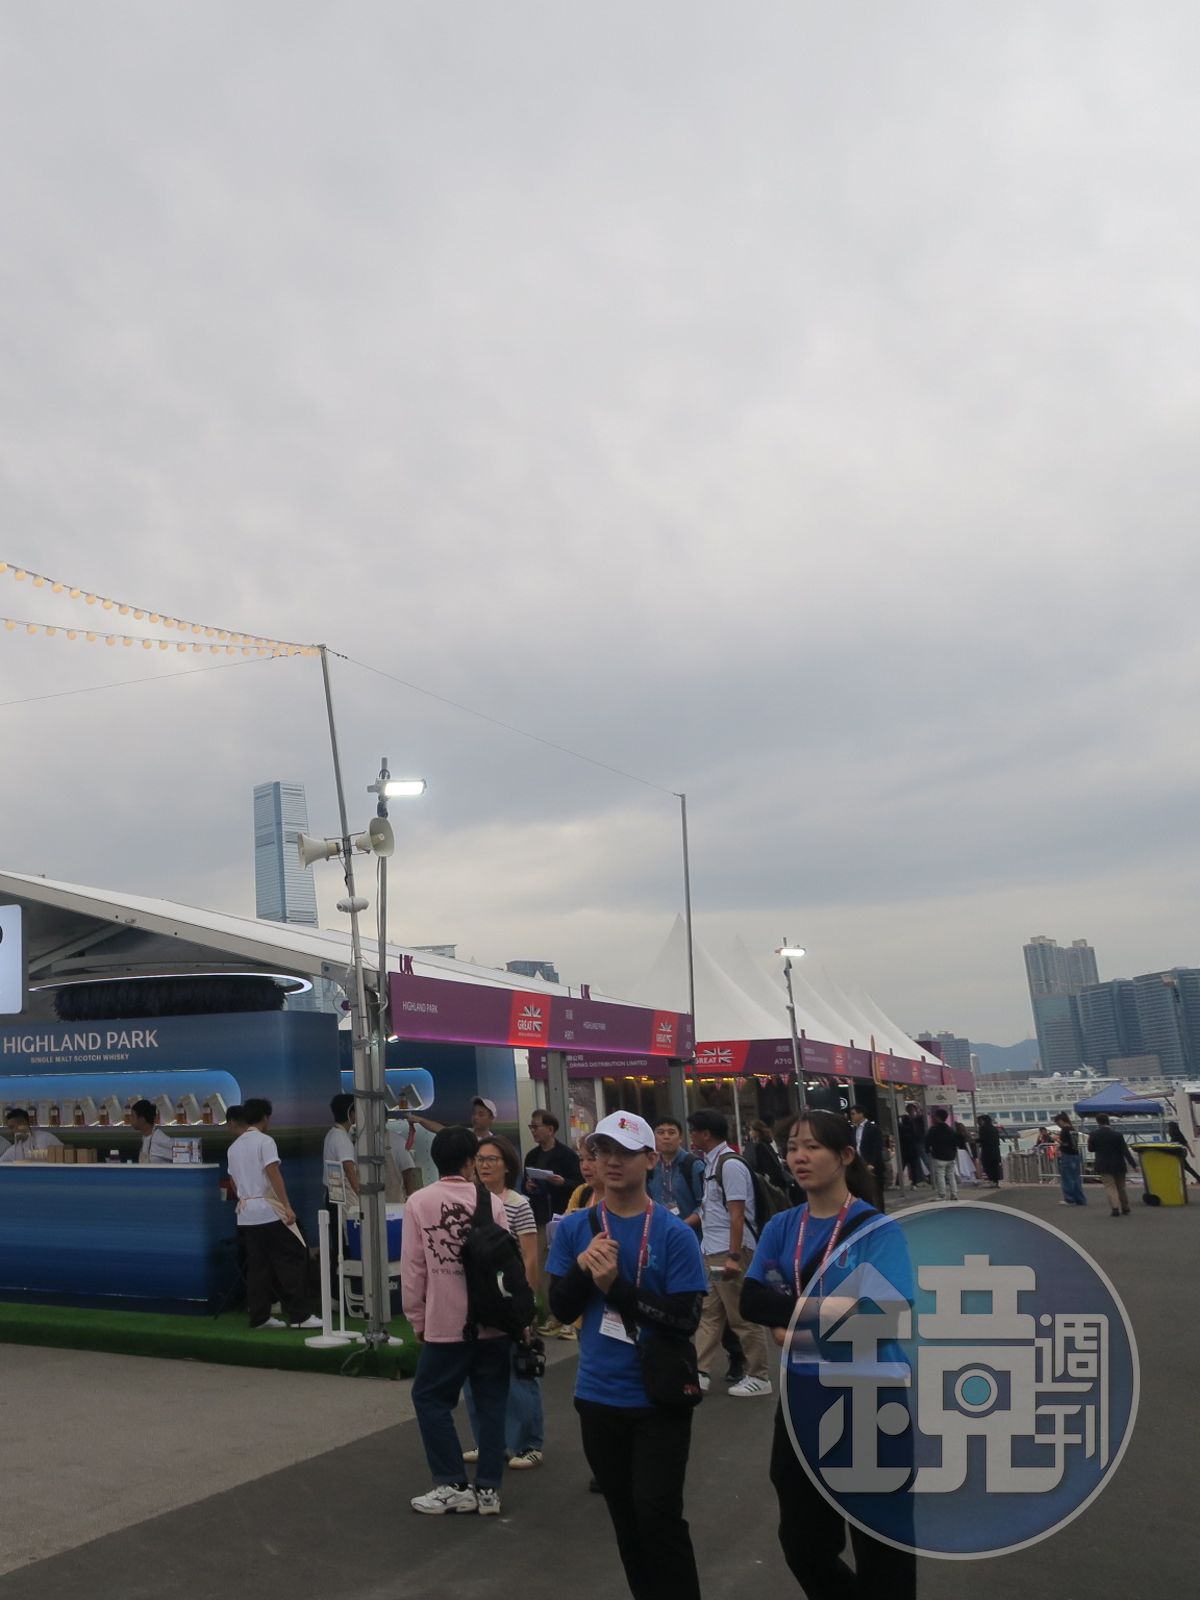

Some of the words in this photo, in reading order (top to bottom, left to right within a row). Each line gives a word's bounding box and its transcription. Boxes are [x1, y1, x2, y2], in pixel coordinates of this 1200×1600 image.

[400, 953, 414, 975] UK
[402, 1001, 426, 1013] HIGHLAND
[426, 1003, 439, 1014] PARK
[3, 1032, 101, 1054] HIGHLAND
[106, 1029, 159, 1050] PARK
[30, 1056, 52, 1064] SINGLE
[55, 1055, 72, 1063] MALT
[74, 1054, 101, 1063] SCOTCH
[103, 1053, 130, 1061] WHISKY
